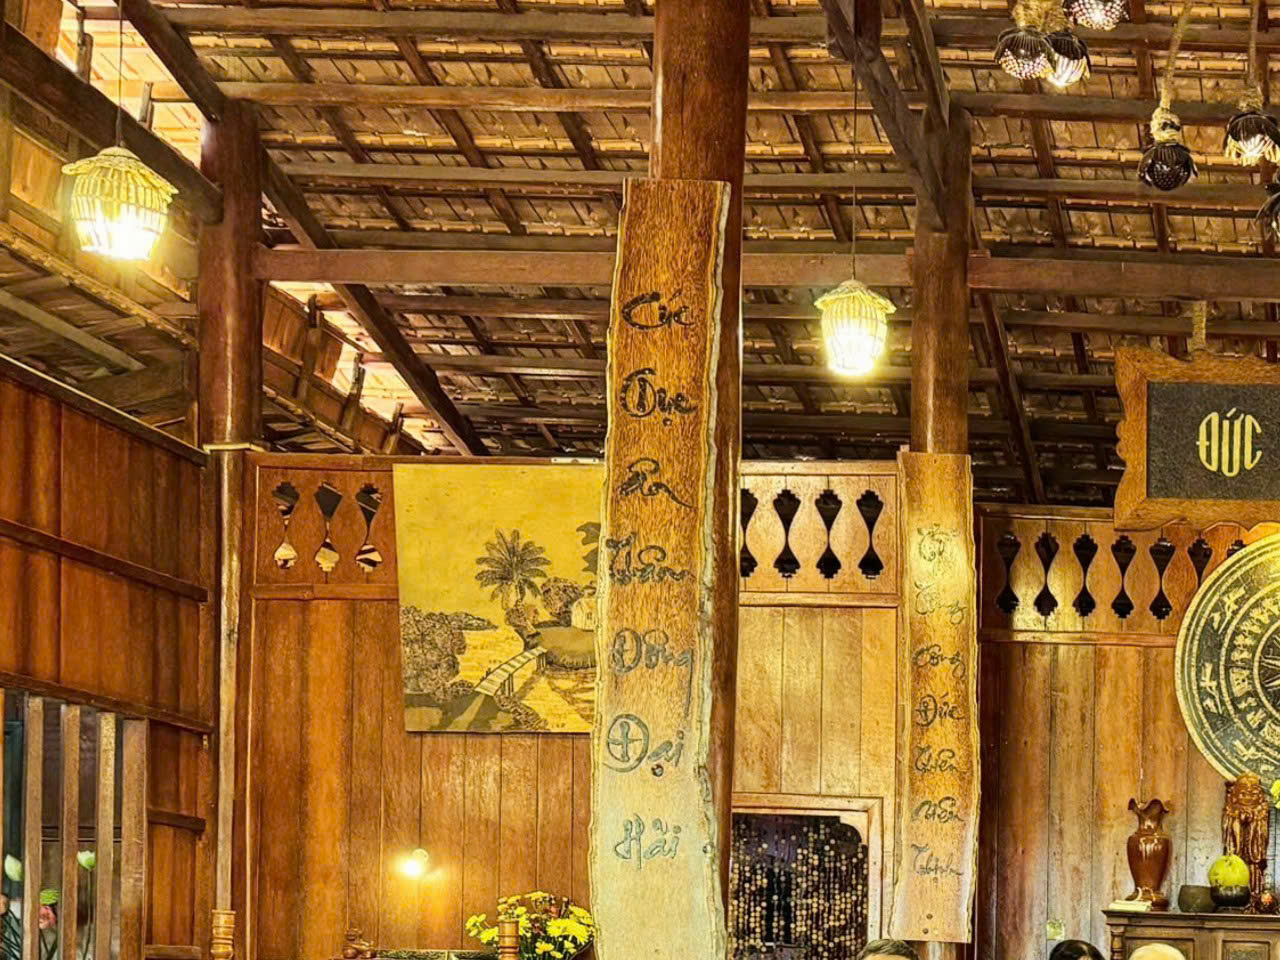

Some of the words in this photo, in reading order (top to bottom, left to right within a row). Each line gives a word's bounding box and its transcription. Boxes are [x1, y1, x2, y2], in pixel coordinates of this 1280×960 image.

[621, 287, 696, 330] Cúc
[1196, 407, 1263, 478] ĐỨC
[914, 690, 970, 730] Đức
[602, 713, 685, 778] Đại
[614, 813, 682, 870] Hải
